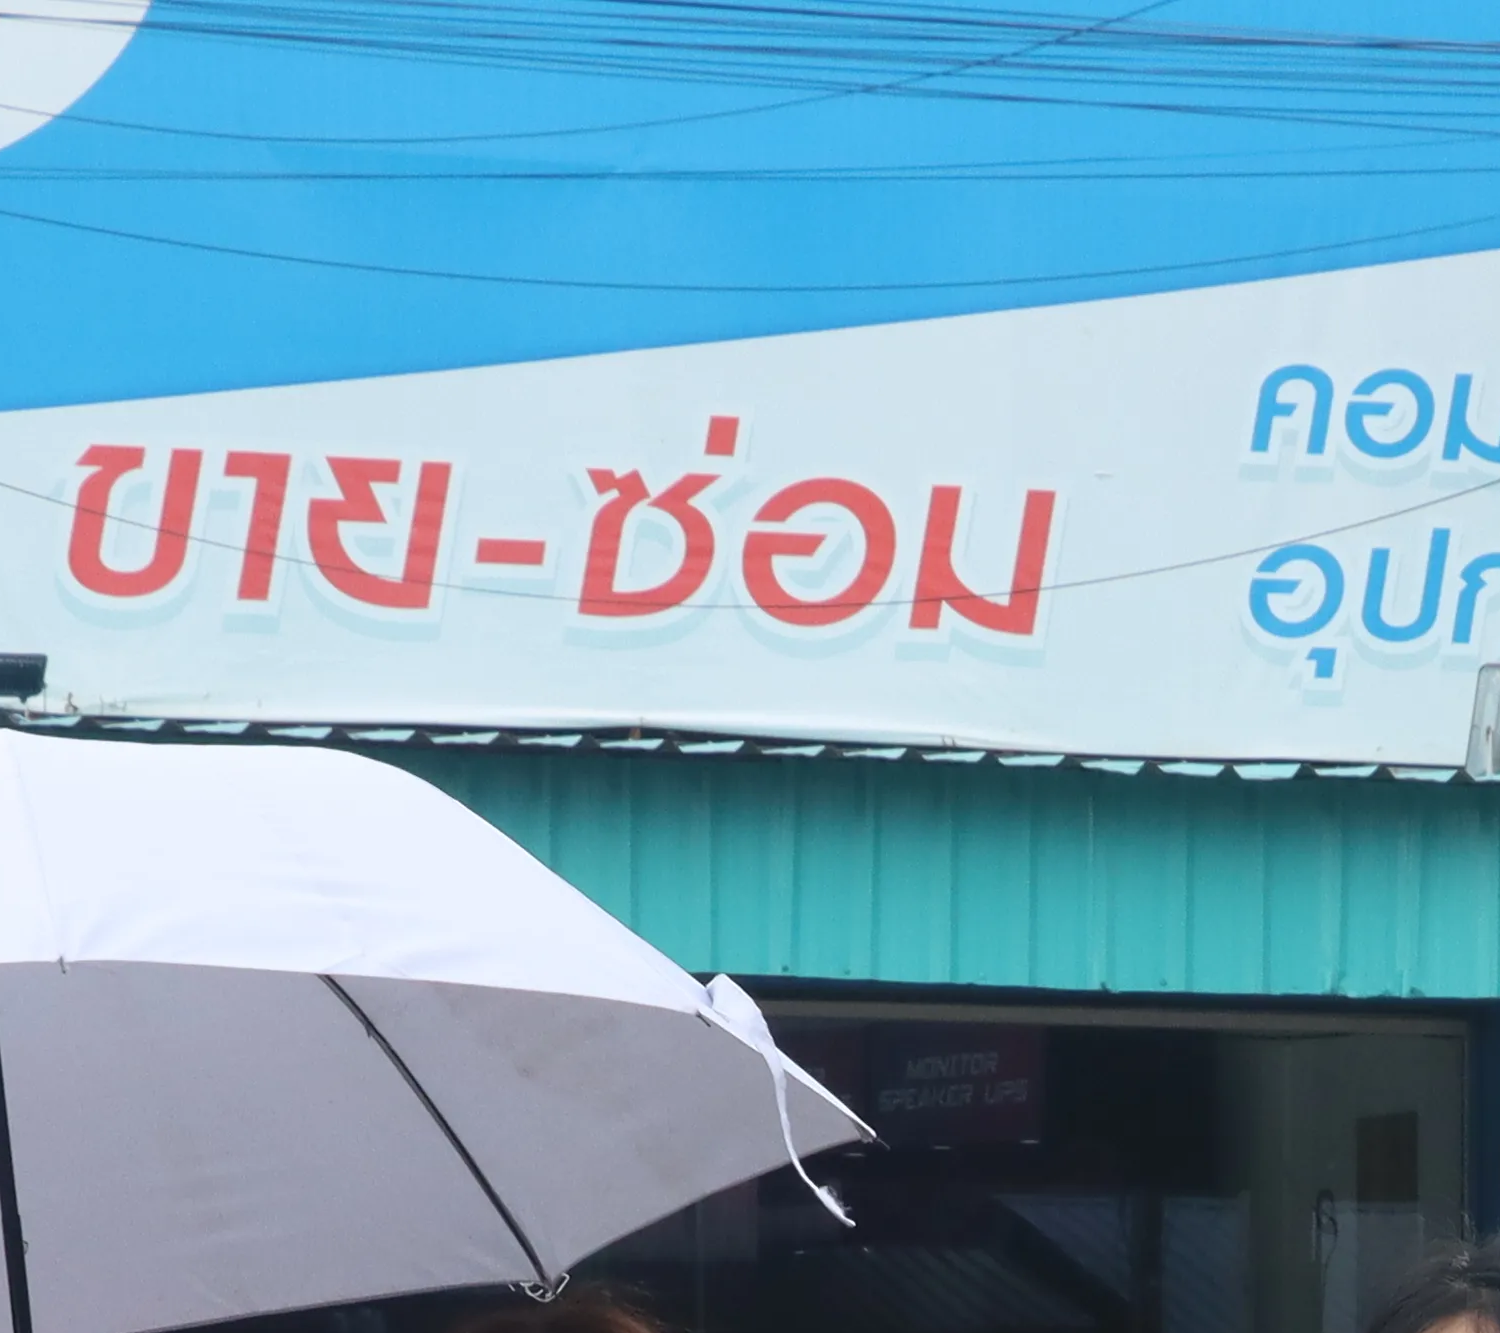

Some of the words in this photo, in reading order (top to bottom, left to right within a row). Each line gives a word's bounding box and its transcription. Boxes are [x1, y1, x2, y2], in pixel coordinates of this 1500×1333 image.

[66, 414, 1057, 637] ขาย-ซ่อม
[906, 1051, 1000, 1081] MONITOR
